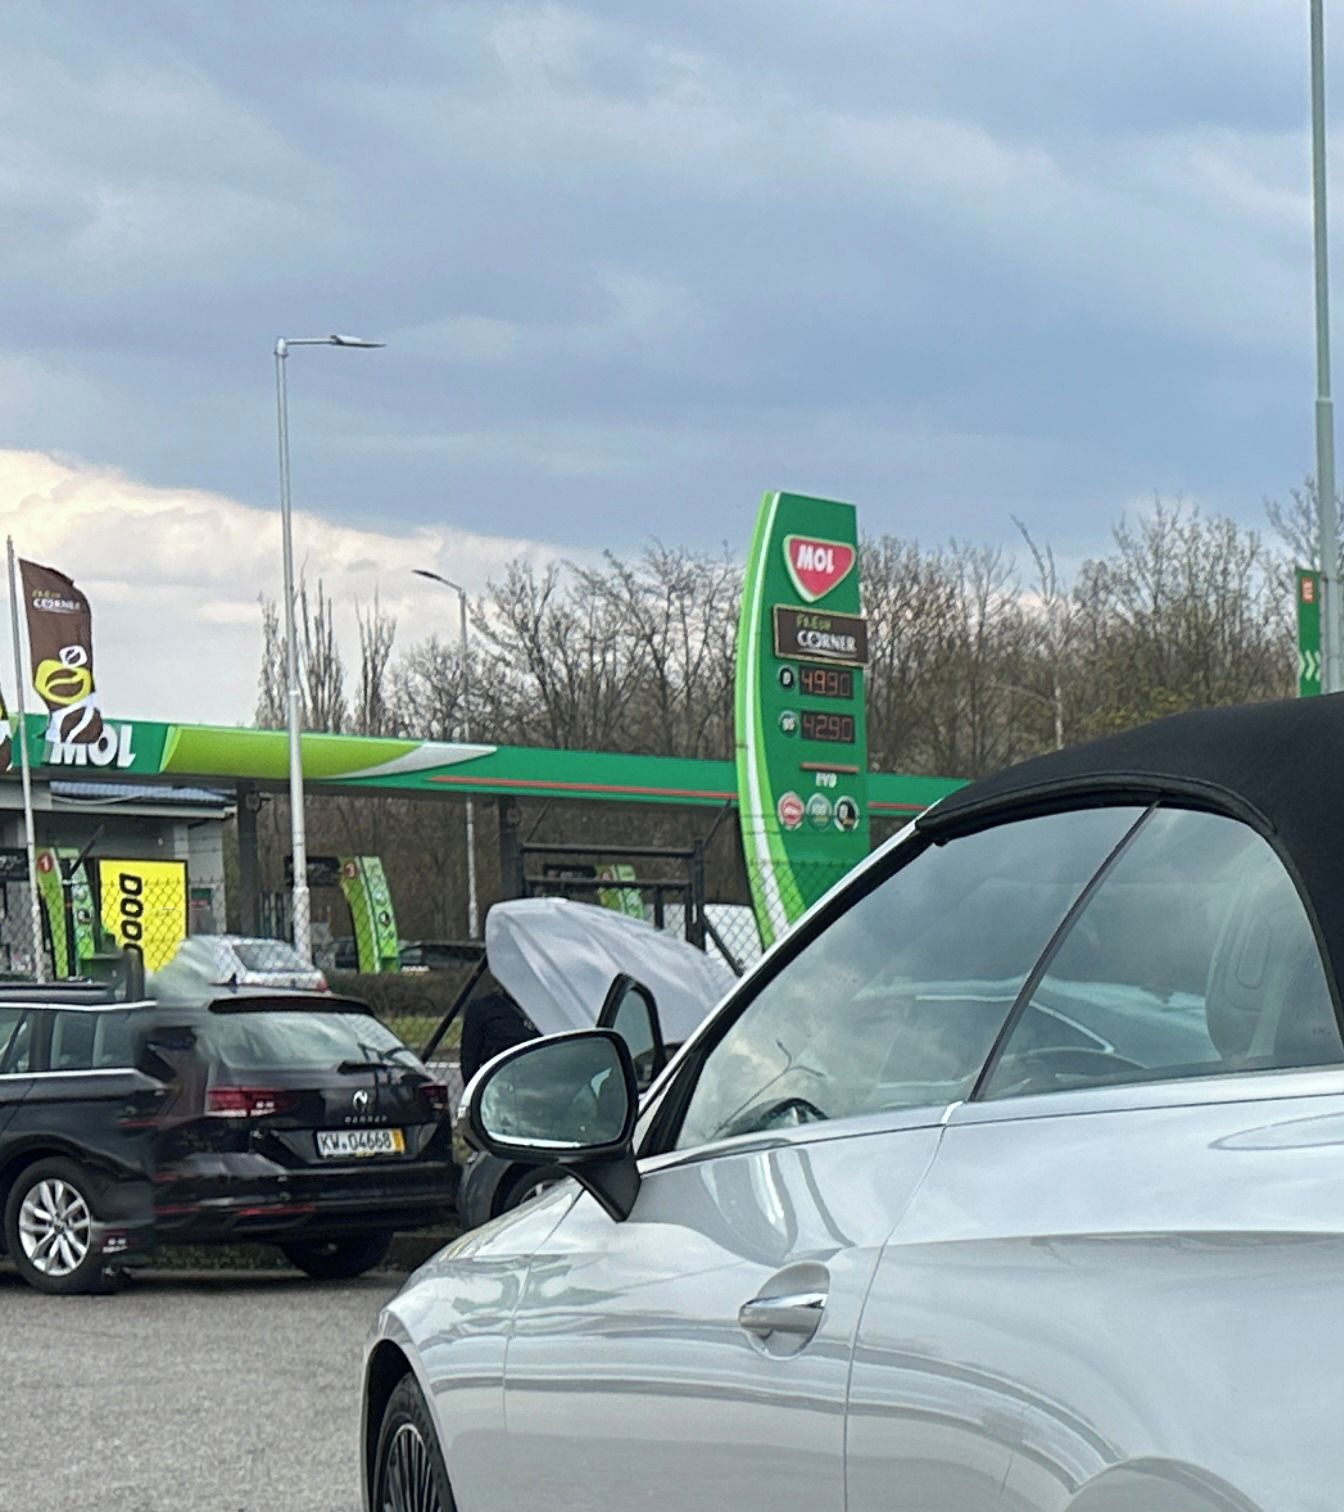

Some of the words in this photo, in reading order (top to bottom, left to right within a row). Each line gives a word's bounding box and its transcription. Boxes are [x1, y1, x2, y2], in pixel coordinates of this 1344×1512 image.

[796, 544, 835, 574] MOL
[797, 629, 858, 653] CORNER
[50, 724, 137, 768] MOL
